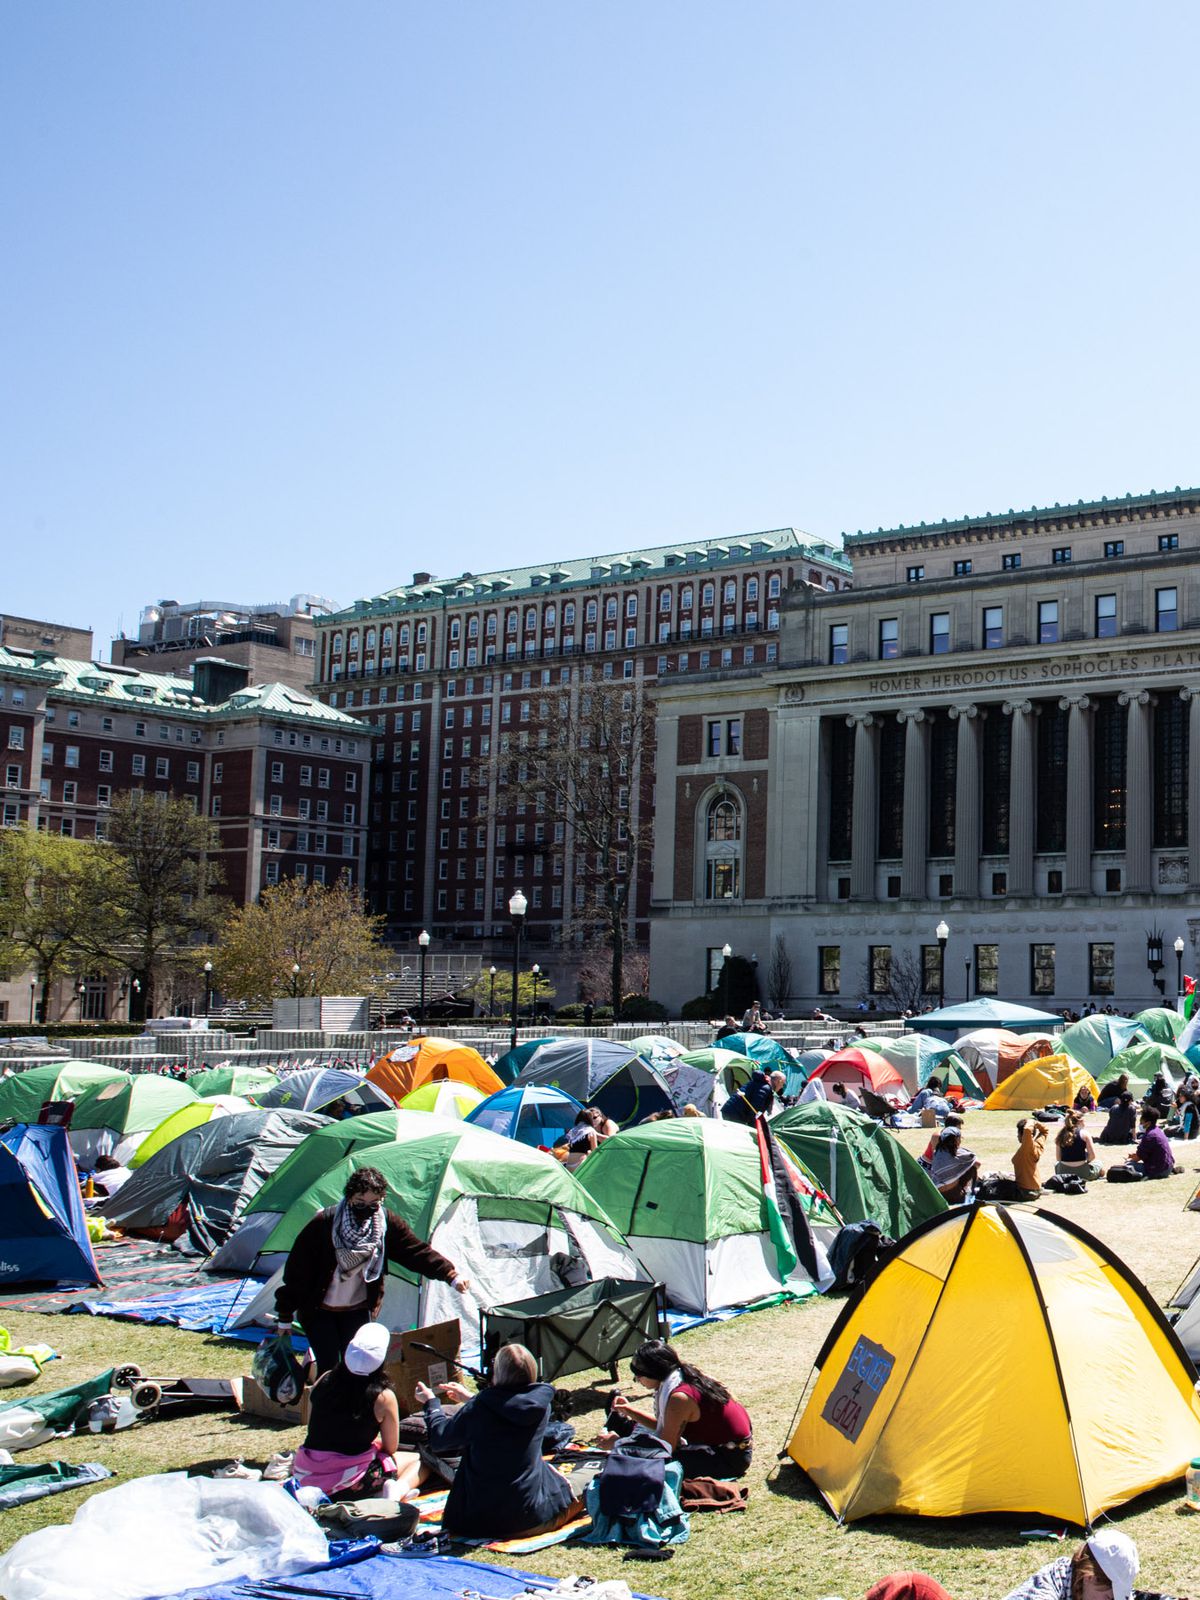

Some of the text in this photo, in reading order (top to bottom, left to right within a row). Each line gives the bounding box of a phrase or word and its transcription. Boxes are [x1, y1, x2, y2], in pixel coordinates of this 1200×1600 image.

[870, 677, 921, 693] HOMER
[932, 667, 1029, 688] HERODOTUS
[1041, 657, 1138, 677] SOPHOCLES
[852, 1380, 863, 1399] 4
[832, 1395, 862, 1434] GAZA
